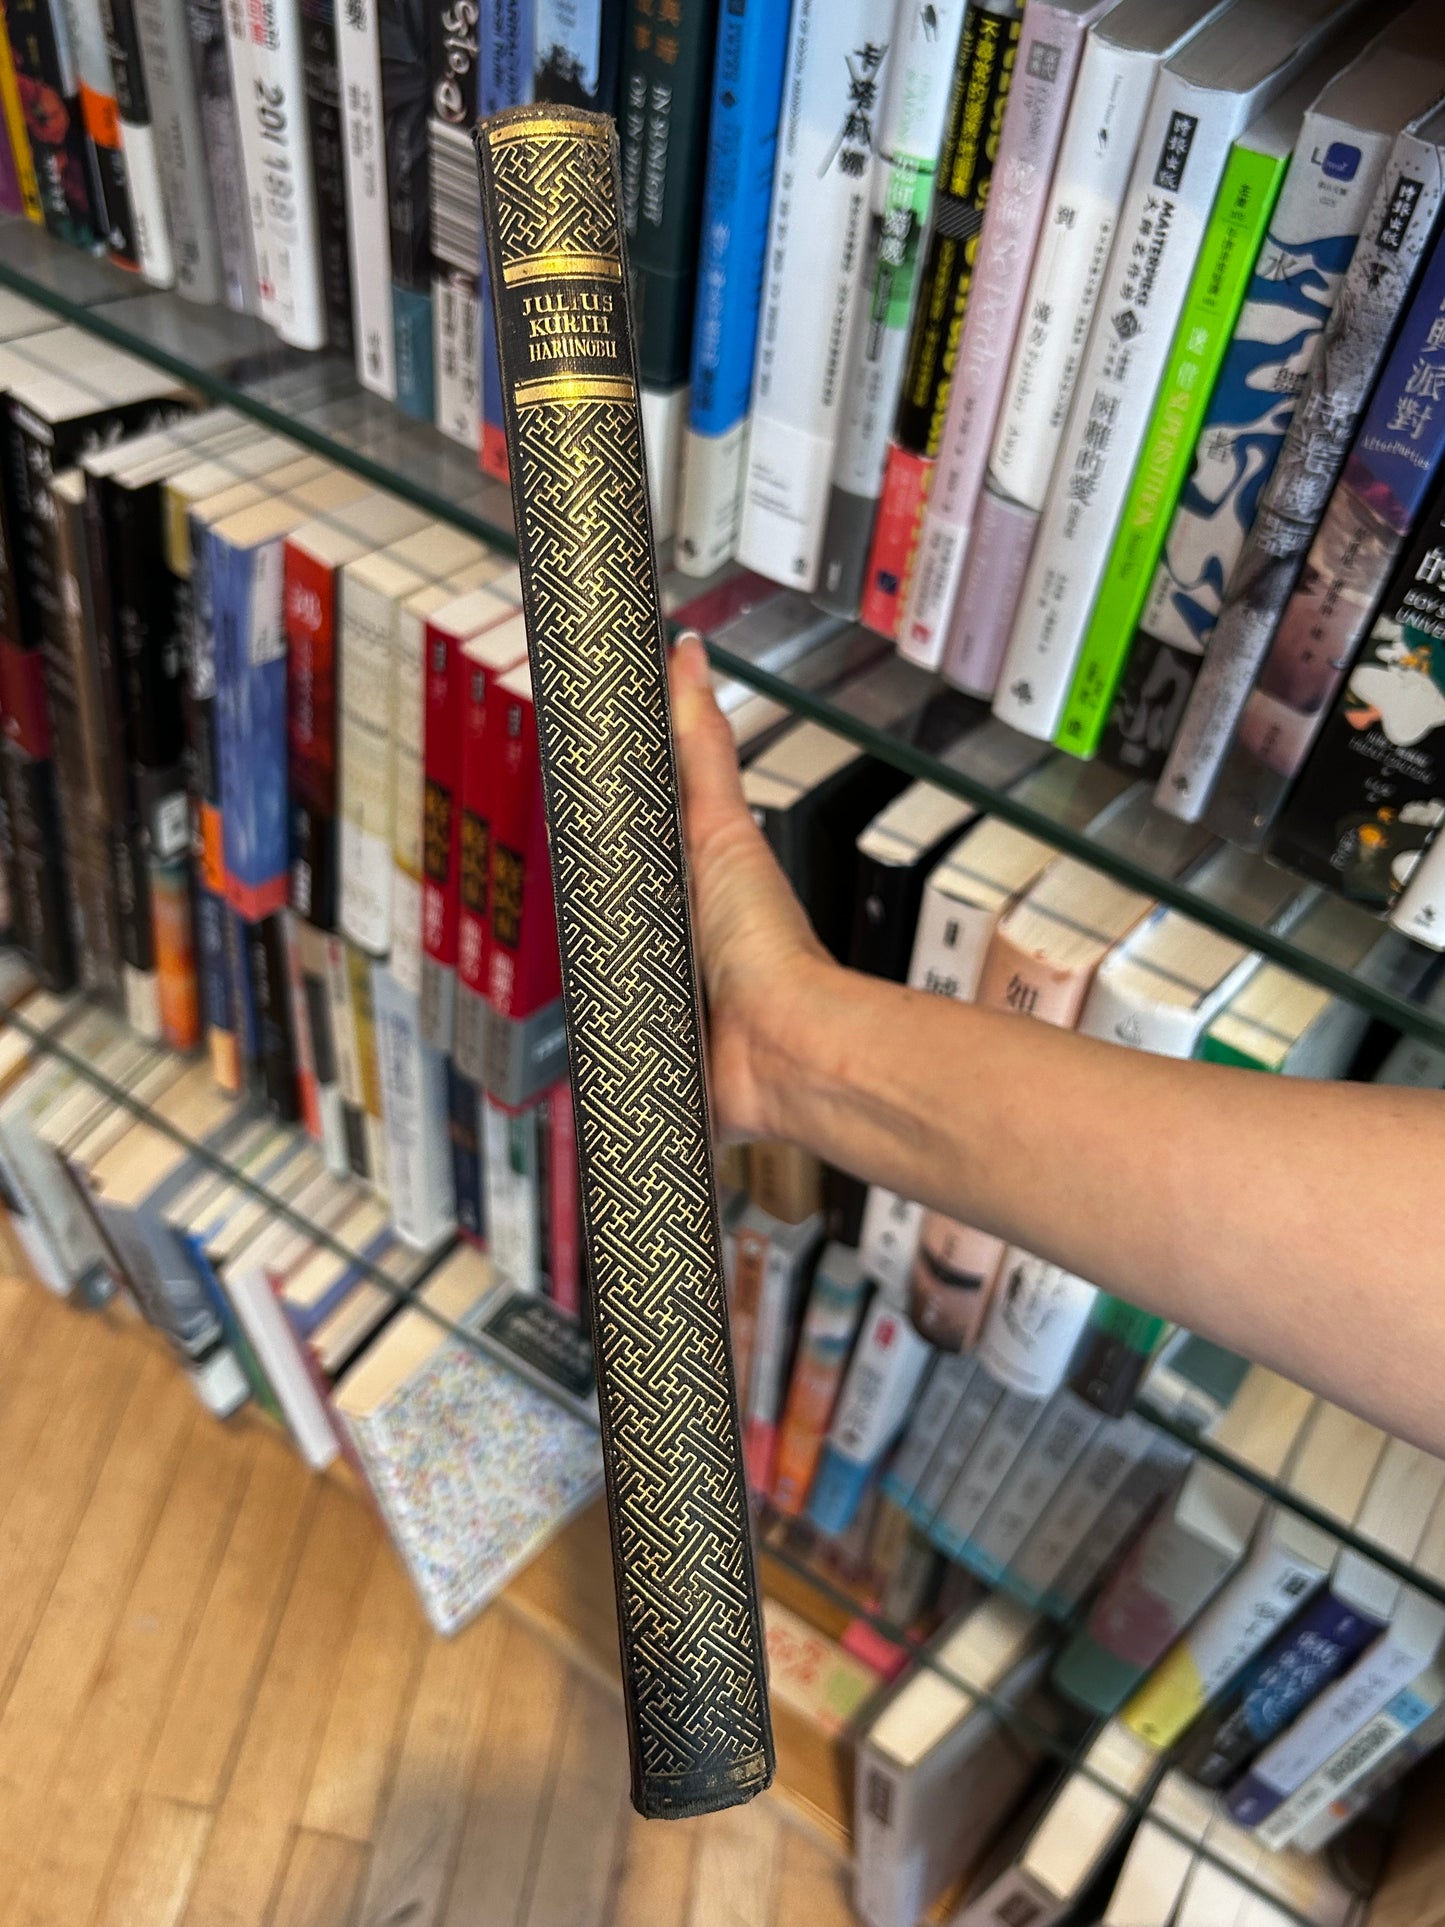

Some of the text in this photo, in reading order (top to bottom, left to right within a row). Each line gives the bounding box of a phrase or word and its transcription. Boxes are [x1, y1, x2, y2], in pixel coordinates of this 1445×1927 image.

[522, 292, 613, 316] JULIUS
[529, 315, 611, 339] KURTH
[529, 338, 617, 363] HARUNOBU
